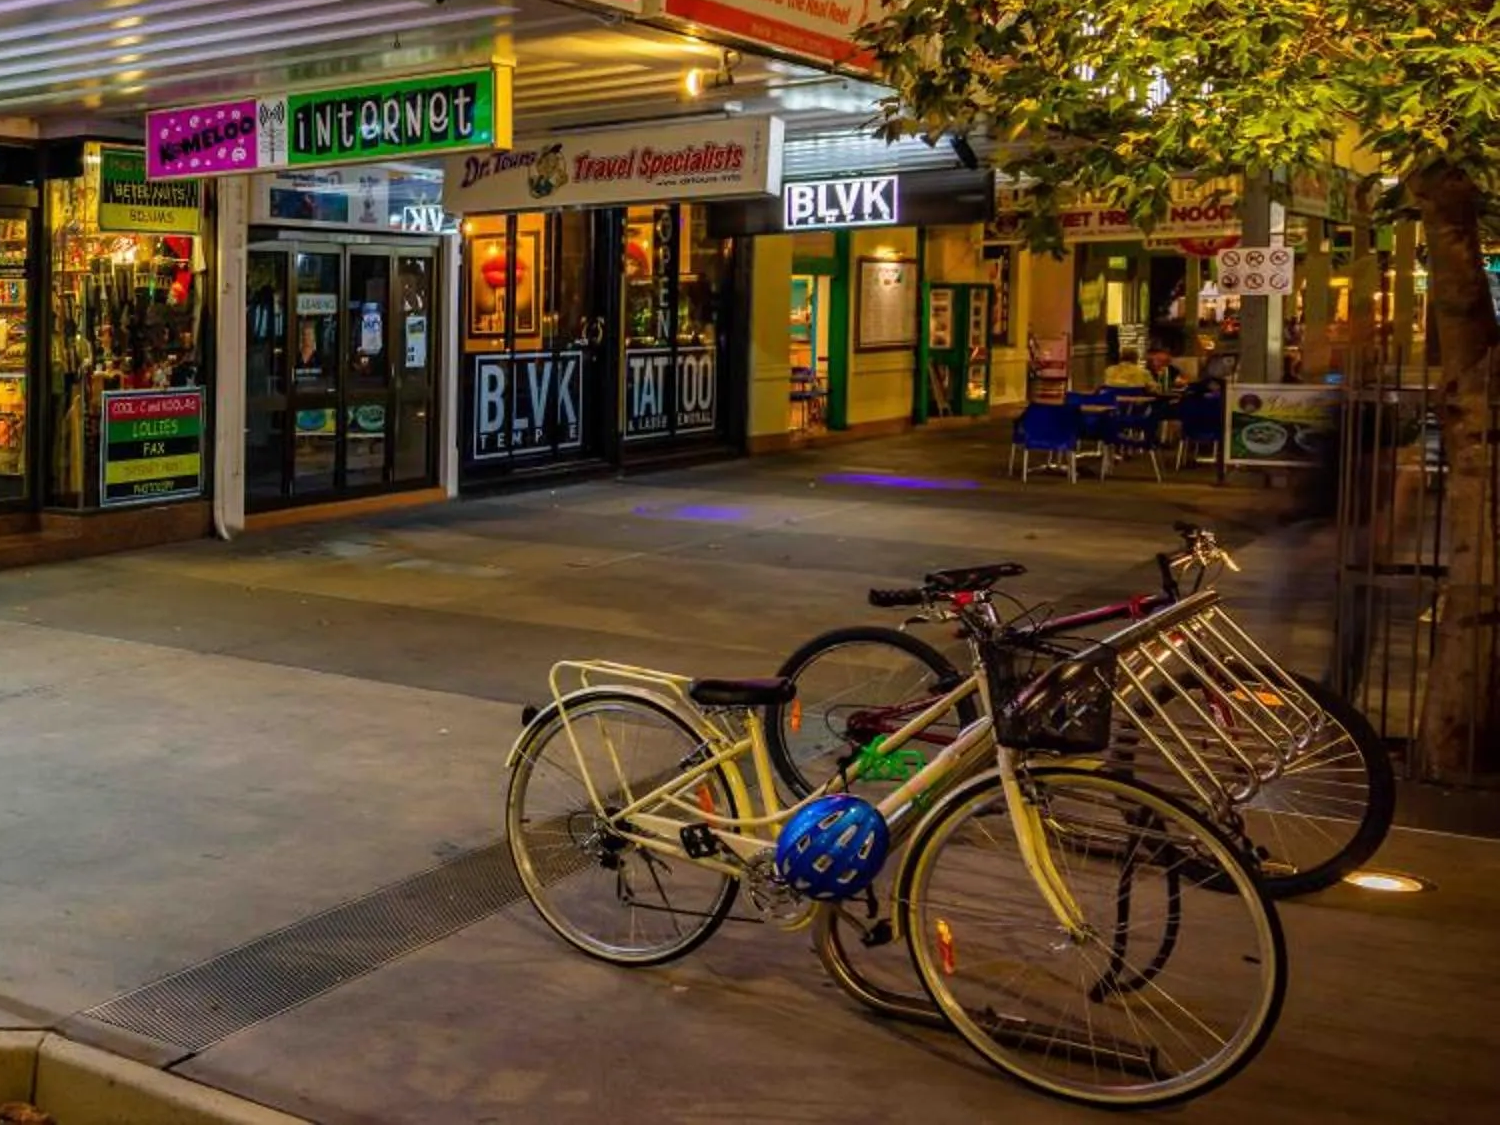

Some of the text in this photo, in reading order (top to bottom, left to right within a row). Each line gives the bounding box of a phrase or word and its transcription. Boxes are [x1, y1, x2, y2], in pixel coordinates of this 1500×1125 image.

[573, 148, 635, 184] Travel
[638, 141, 744, 185] Specialists
[792, 179, 890, 221] BLVK
[481, 360, 577, 434] BLVK
[132, 418, 179, 438] LOLLIES
[480, 427, 577, 452] TEMPE
[143, 442, 165, 456] FAX
